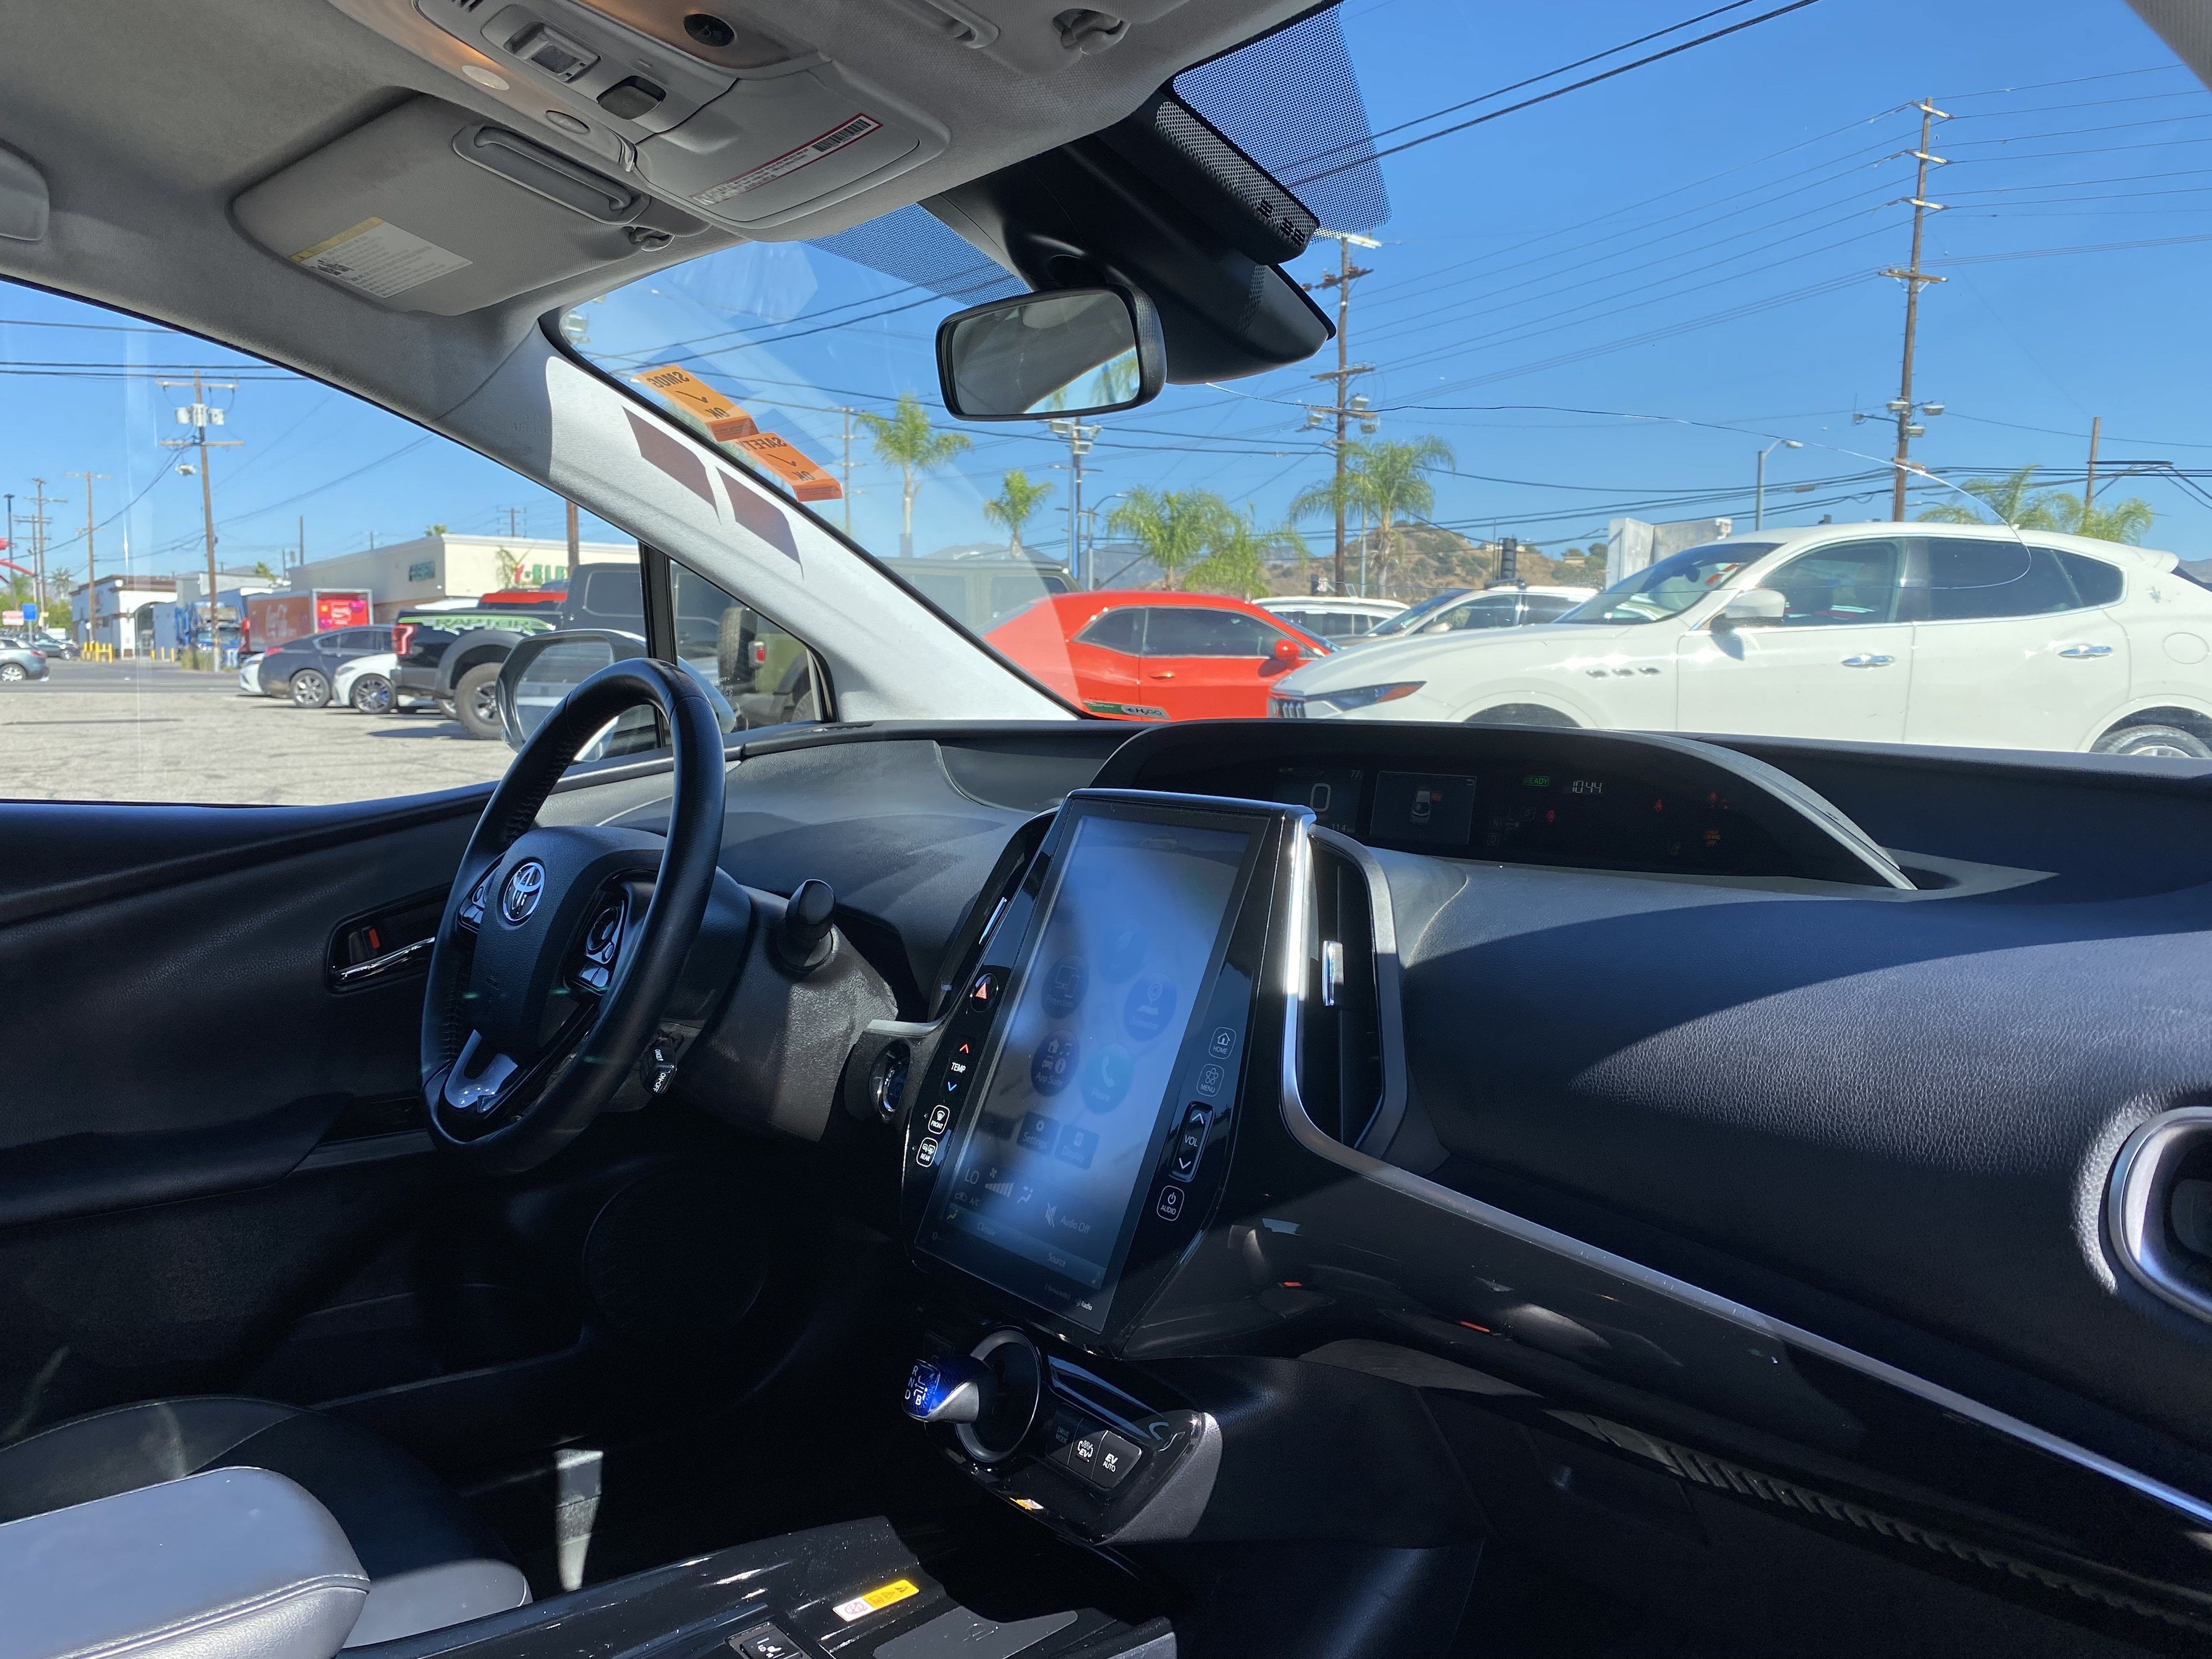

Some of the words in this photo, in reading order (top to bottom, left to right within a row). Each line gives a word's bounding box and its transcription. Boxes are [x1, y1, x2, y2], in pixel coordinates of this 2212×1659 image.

[432, 618, 536, 635] RAPTOR
[1524, 776, 1548, 785] READY
[1310, 783, 1331, 812] 0
[1213, 1046, 1228, 1054] HOME
[951, 1062, 966, 1073] TEMP
[653, 1073, 666, 1093] ON-OFF
[1036, 1072, 1047, 1084] App
[1048, 1075, 1063, 1086] Suite
[1200, 1084, 1215, 1093] MENU
[1090, 1088, 1111, 1102] Phone
[930, 1121, 944, 1130] FRONT
[1022, 1132, 1048, 1149] Settings
[1184, 1135, 1198, 1147] VOL
[920, 1153, 931, 1162] REAR
[1062, 1145, 1086, 1163] Display
[964, 1167, 980, 1184] LO
[969, 1197, 981, 1207] A/C
[1160, 1204, 1177, 1215] AUDIO
[1060, 1215, 1077, 1229] Audio
[1077, 1222, 1091, 1234] Off
[1047, 1252, 1066, 1268] Source
[912, 1365, 918, 1376] R
[908, 1377, 915, 1387] N
[905, 1389, 911, 1400] D
[915, 1395, 922, 1406] B
[1057, 1426, 1070, 1438] DRIVE
[1056, 1433, 1068, 1444] MODE
[1078, 1448, 1088, 1458] EV
[1105, 1453, 1119, 1464] EV
[1102, 1460, 1116, 1472] AUTO
